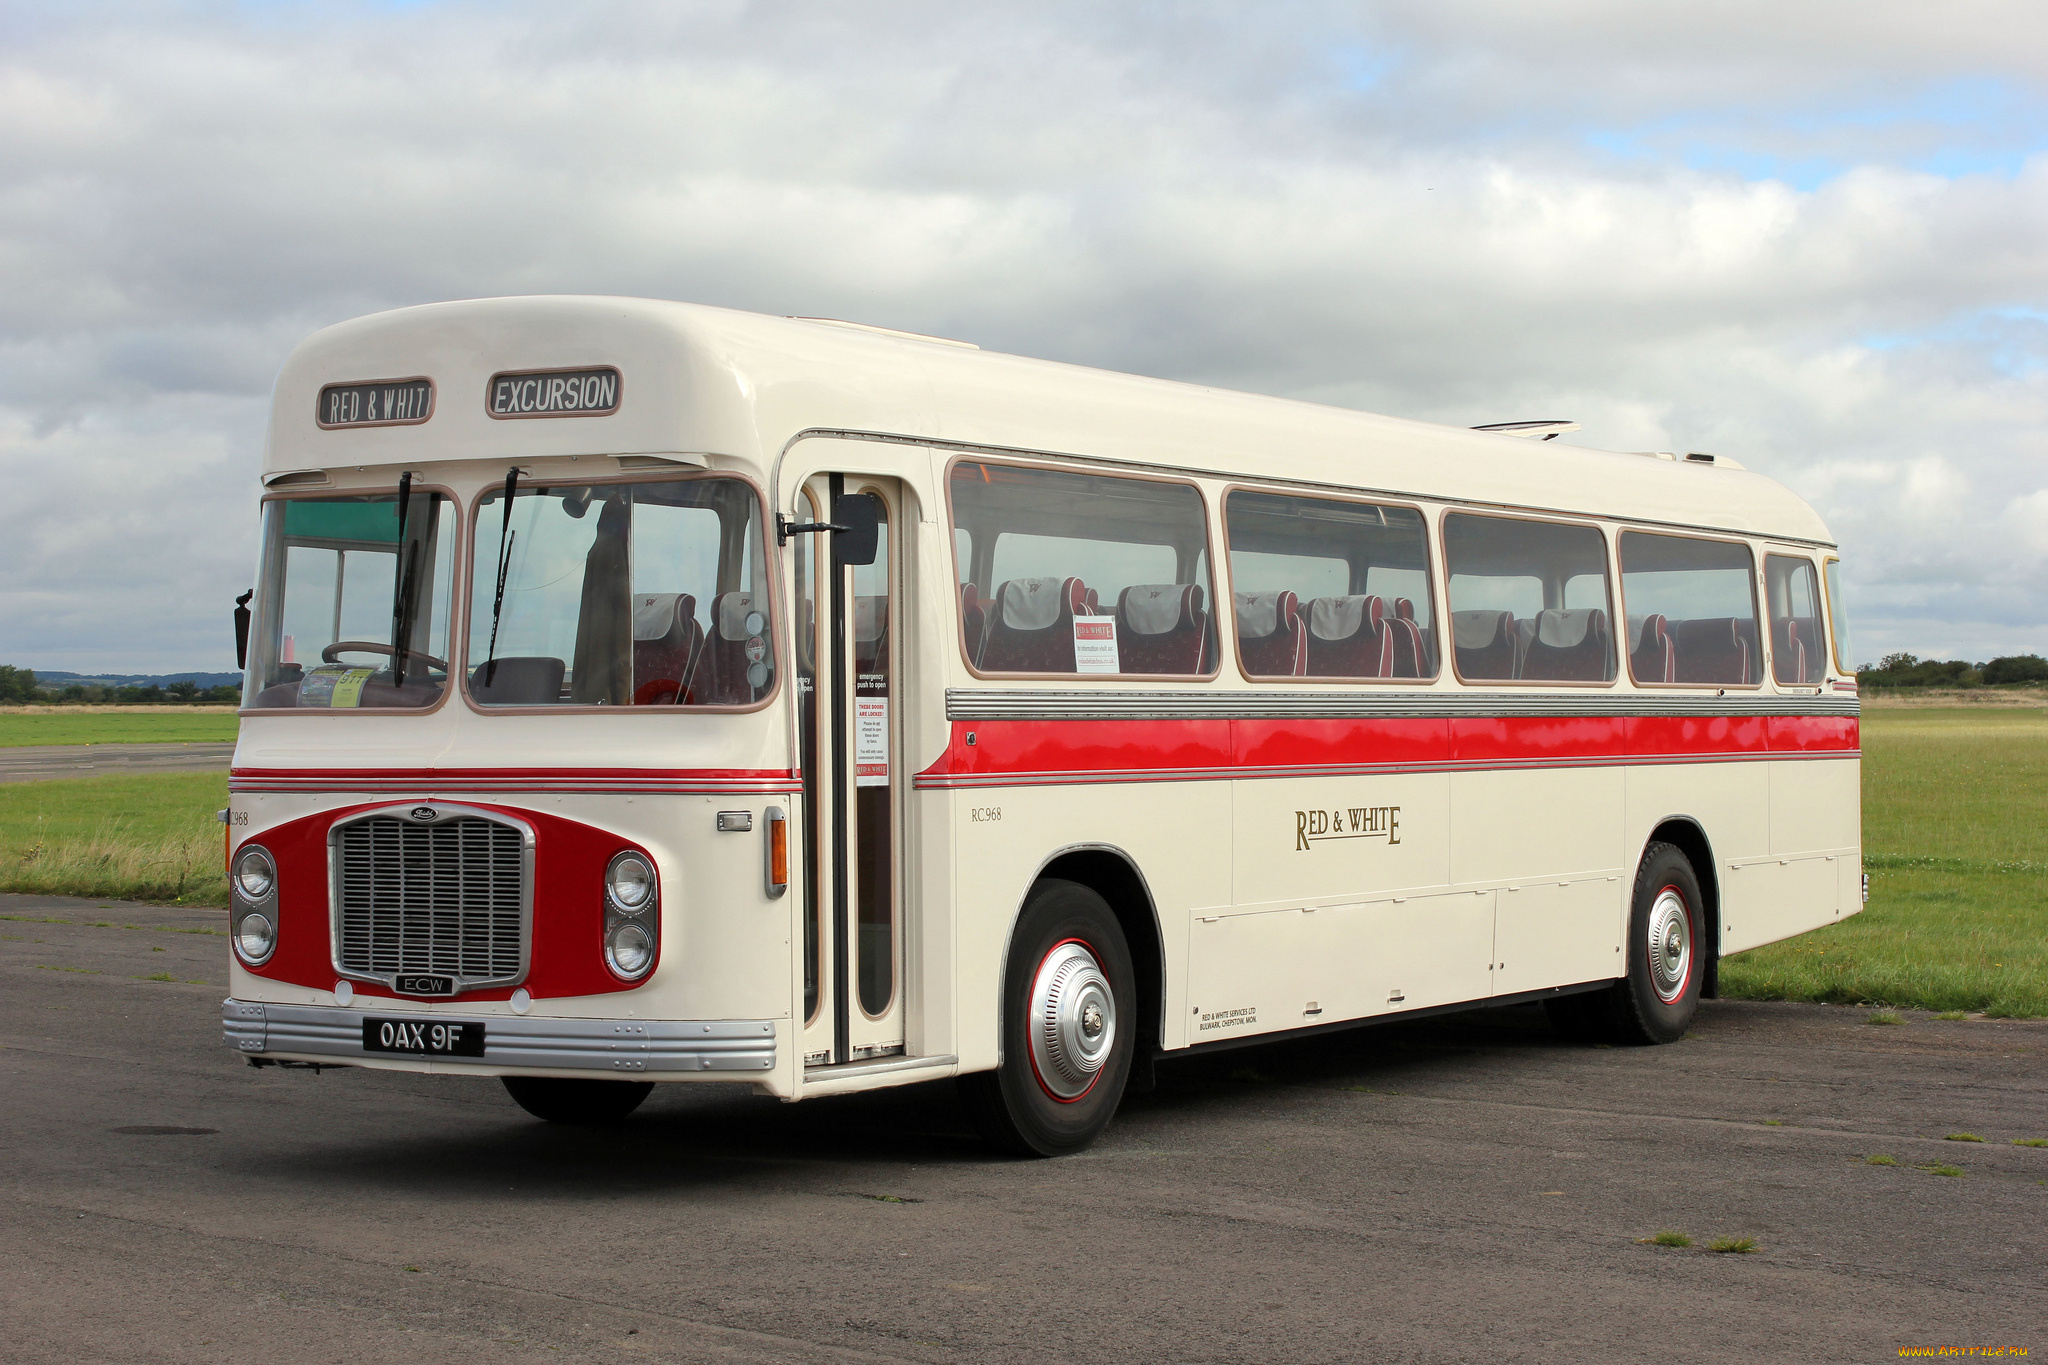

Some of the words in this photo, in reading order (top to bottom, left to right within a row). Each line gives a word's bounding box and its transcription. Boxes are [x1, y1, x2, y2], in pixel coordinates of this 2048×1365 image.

[494, 375, 616, 413] EXCURSION
[330, 392, 359, 424] RED
[367, 390, 377, 421] &
[1090, 626, 1112, 638] WHITE
[859, 674, 884, 682] emergency
[1295, 810, 1328, 851] RED
[1333, 810, 1343, 833] &
[1347, 806, 1401, 845] WHITE
[404, 978, 443, 991] ECW
[1202, 1013, 1211, 1021] RED
[1215, 1010, 1229, 1019] WHITE
[1229, 1008, 1248, 1018] SERVICES
[1248, 1007, 1256, 1015] LTD
[380, 1022, 425, 1050] OAX
[431, 1024, 463, 1051] 9F
